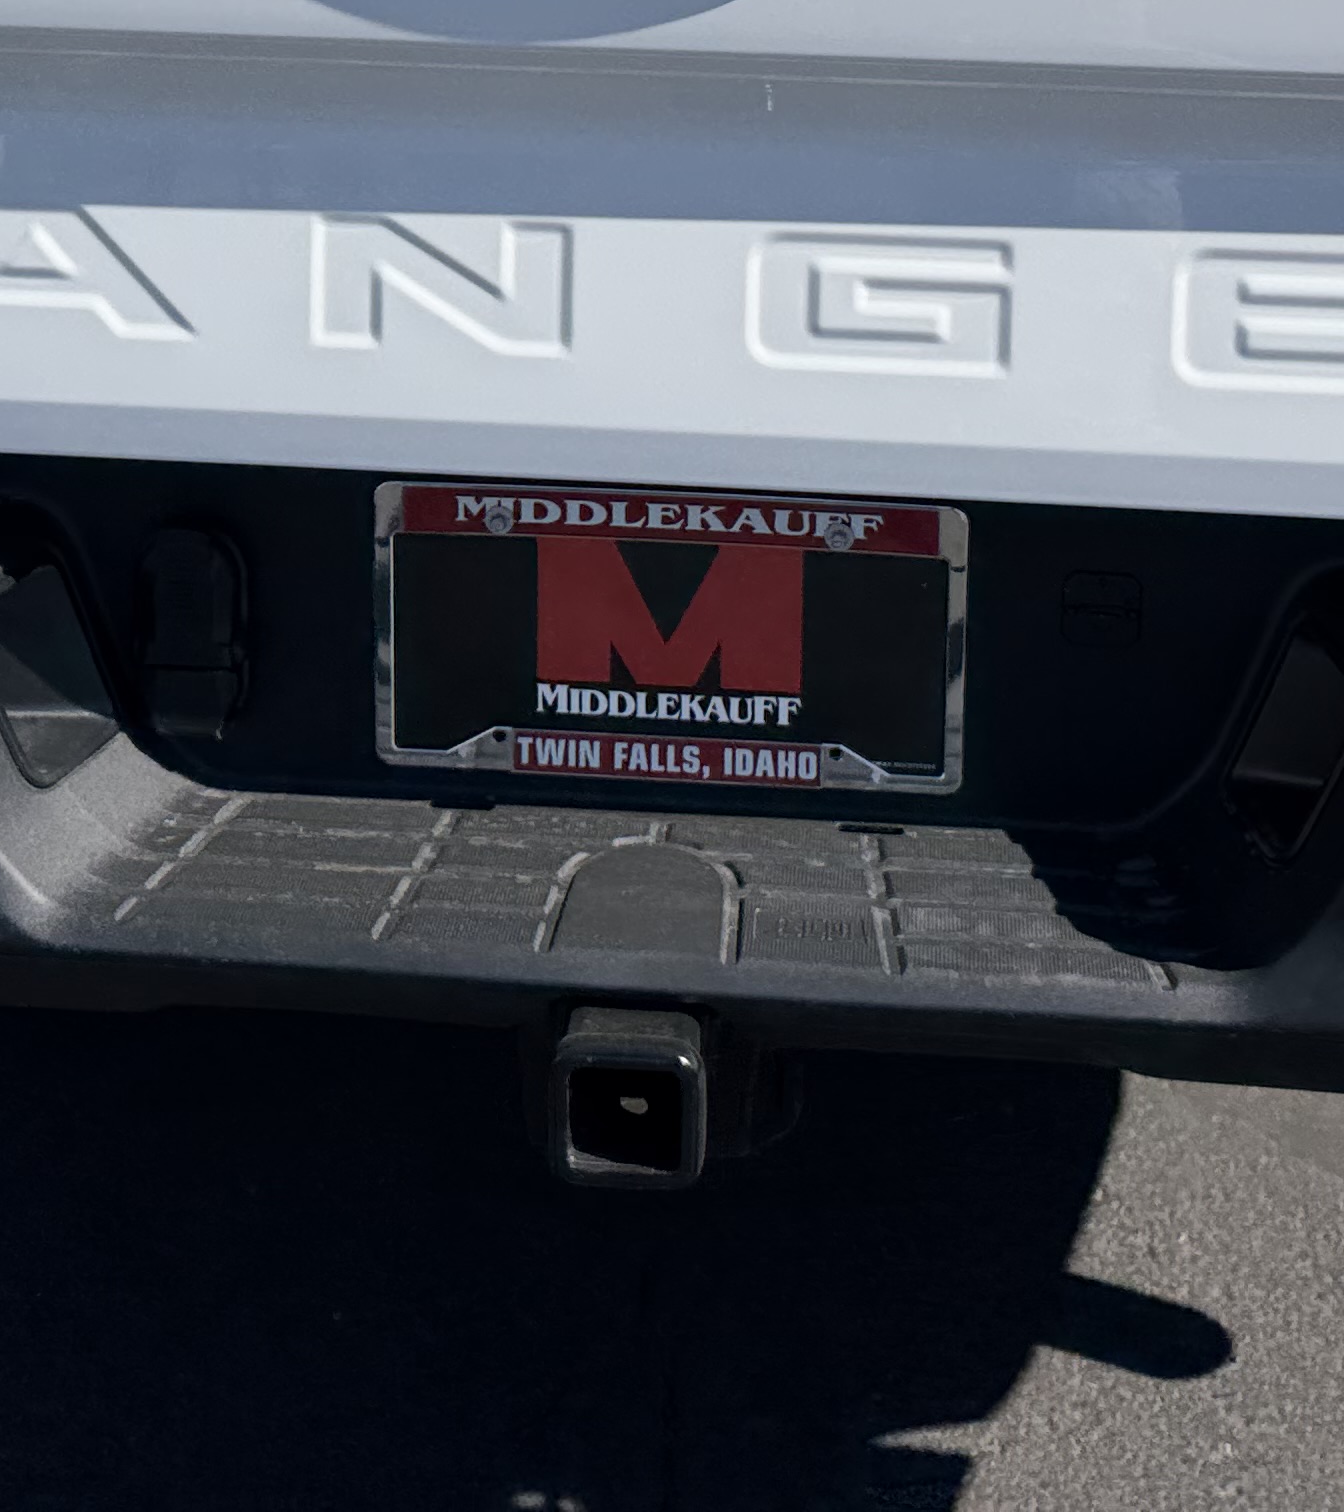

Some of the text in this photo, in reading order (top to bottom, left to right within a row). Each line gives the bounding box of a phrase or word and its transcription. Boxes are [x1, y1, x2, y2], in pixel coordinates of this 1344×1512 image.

[536, 683, 802, 727] MIDDLEKAUFF
[517, 736, 819, 780] TWIN FALLS, IDAHO
